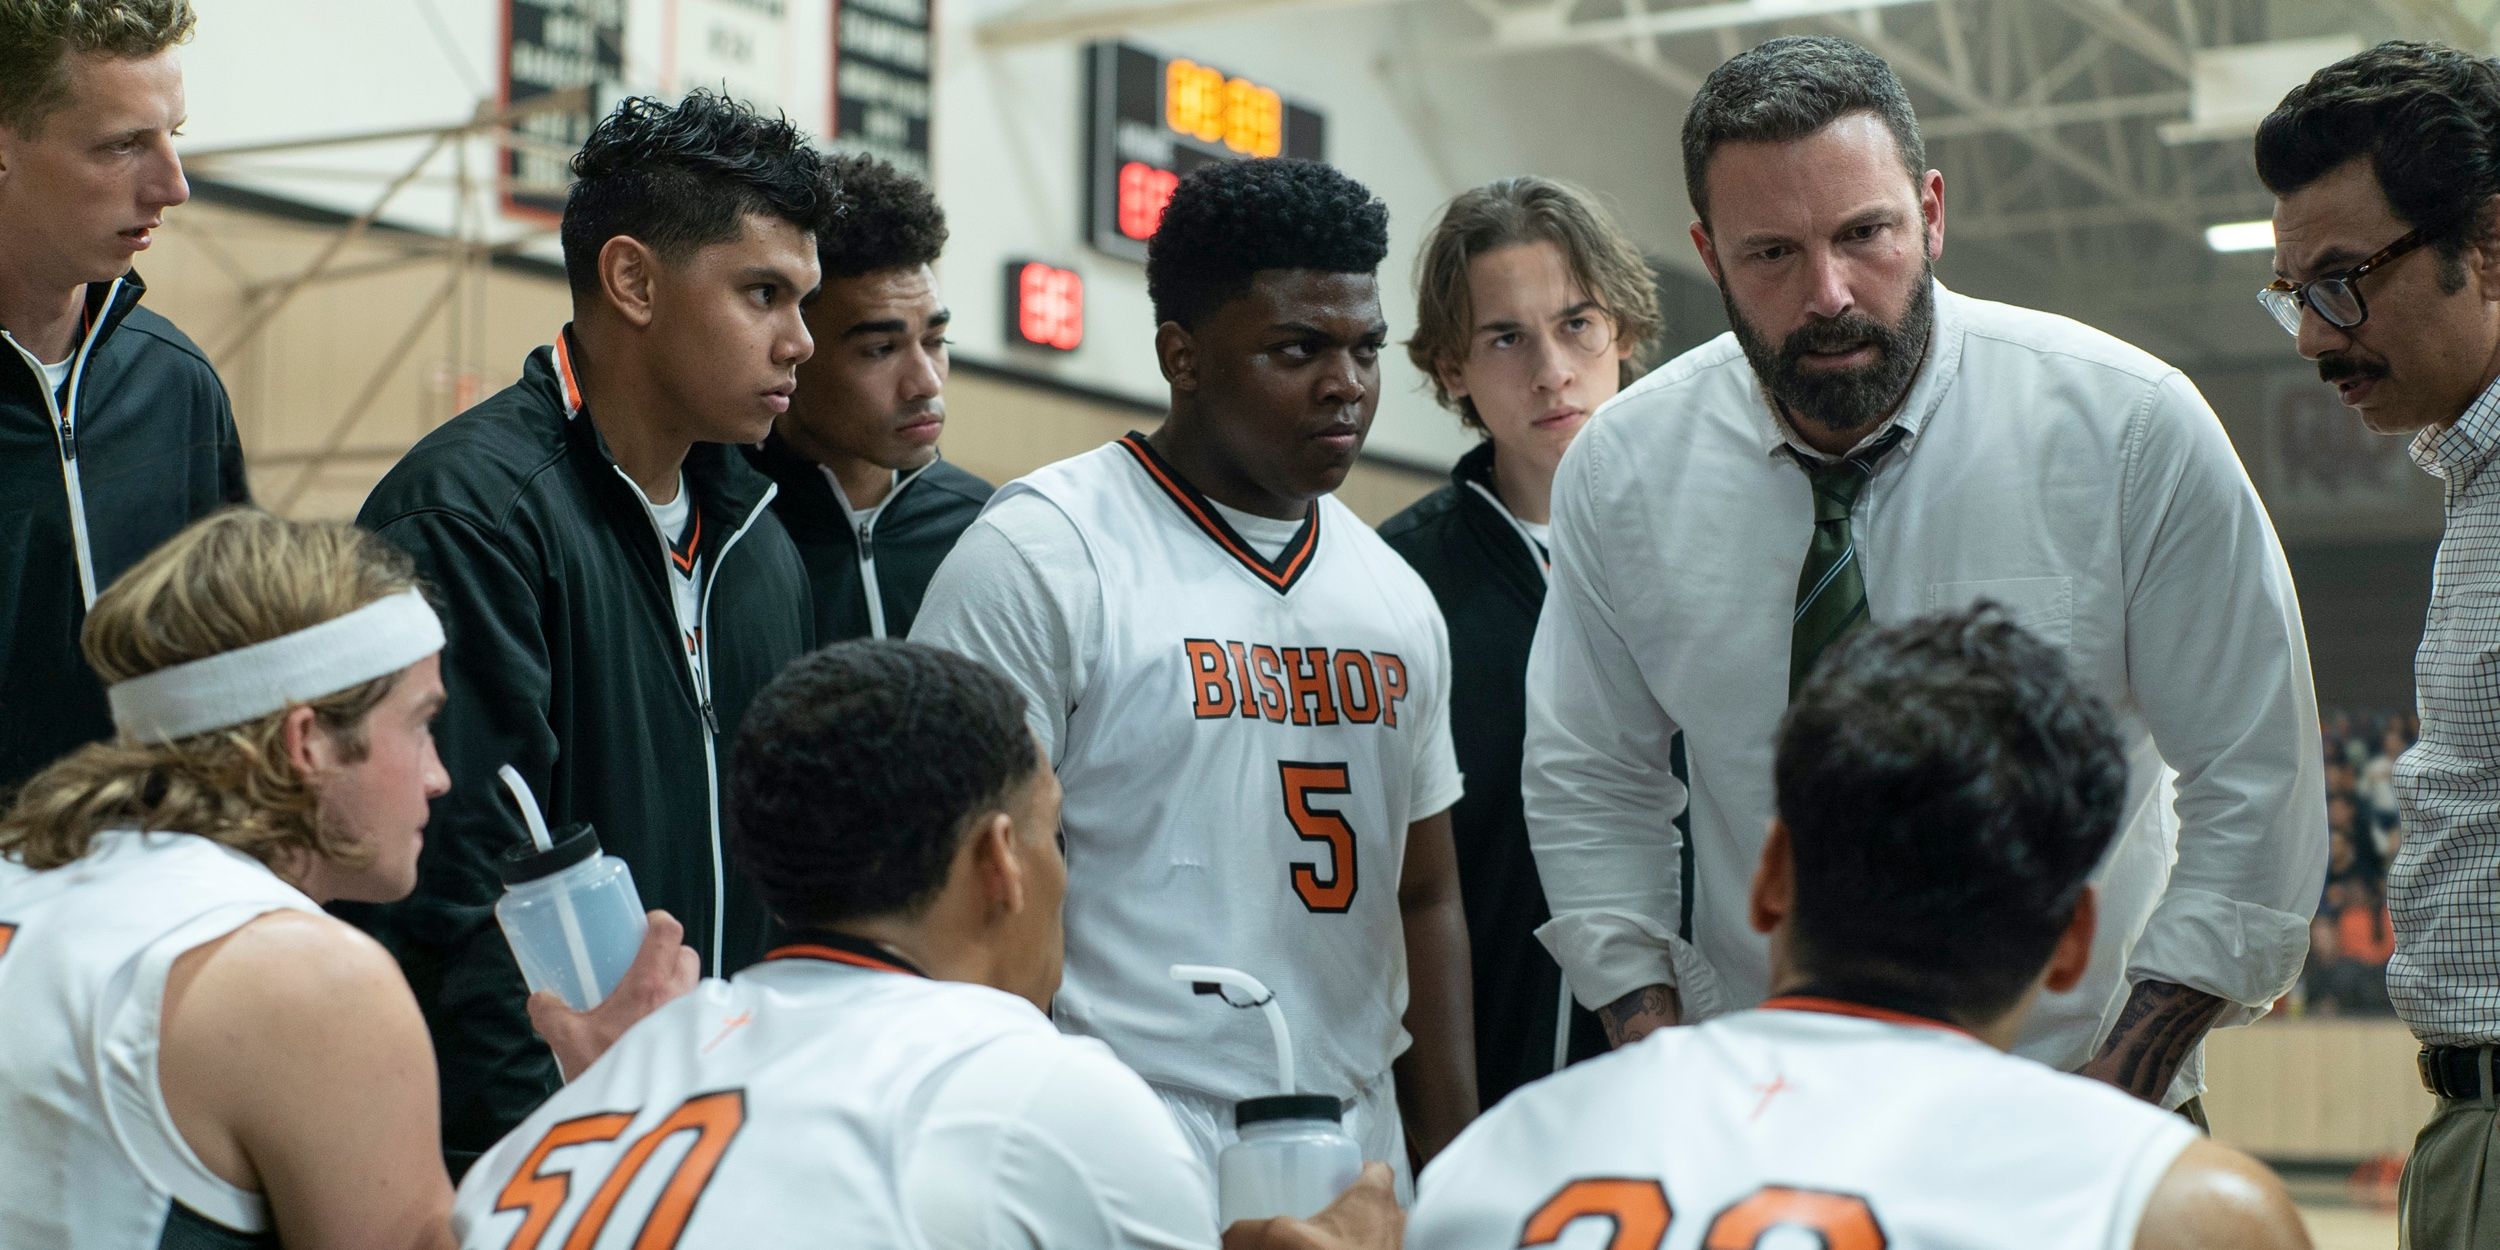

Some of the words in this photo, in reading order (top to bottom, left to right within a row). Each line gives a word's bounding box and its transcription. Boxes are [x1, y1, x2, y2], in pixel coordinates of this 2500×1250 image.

[1184, 638, 1408, 729] BISHOP
[1277, 760, 1358, 914] 5
[493, 1087, 748, 1250] 50
